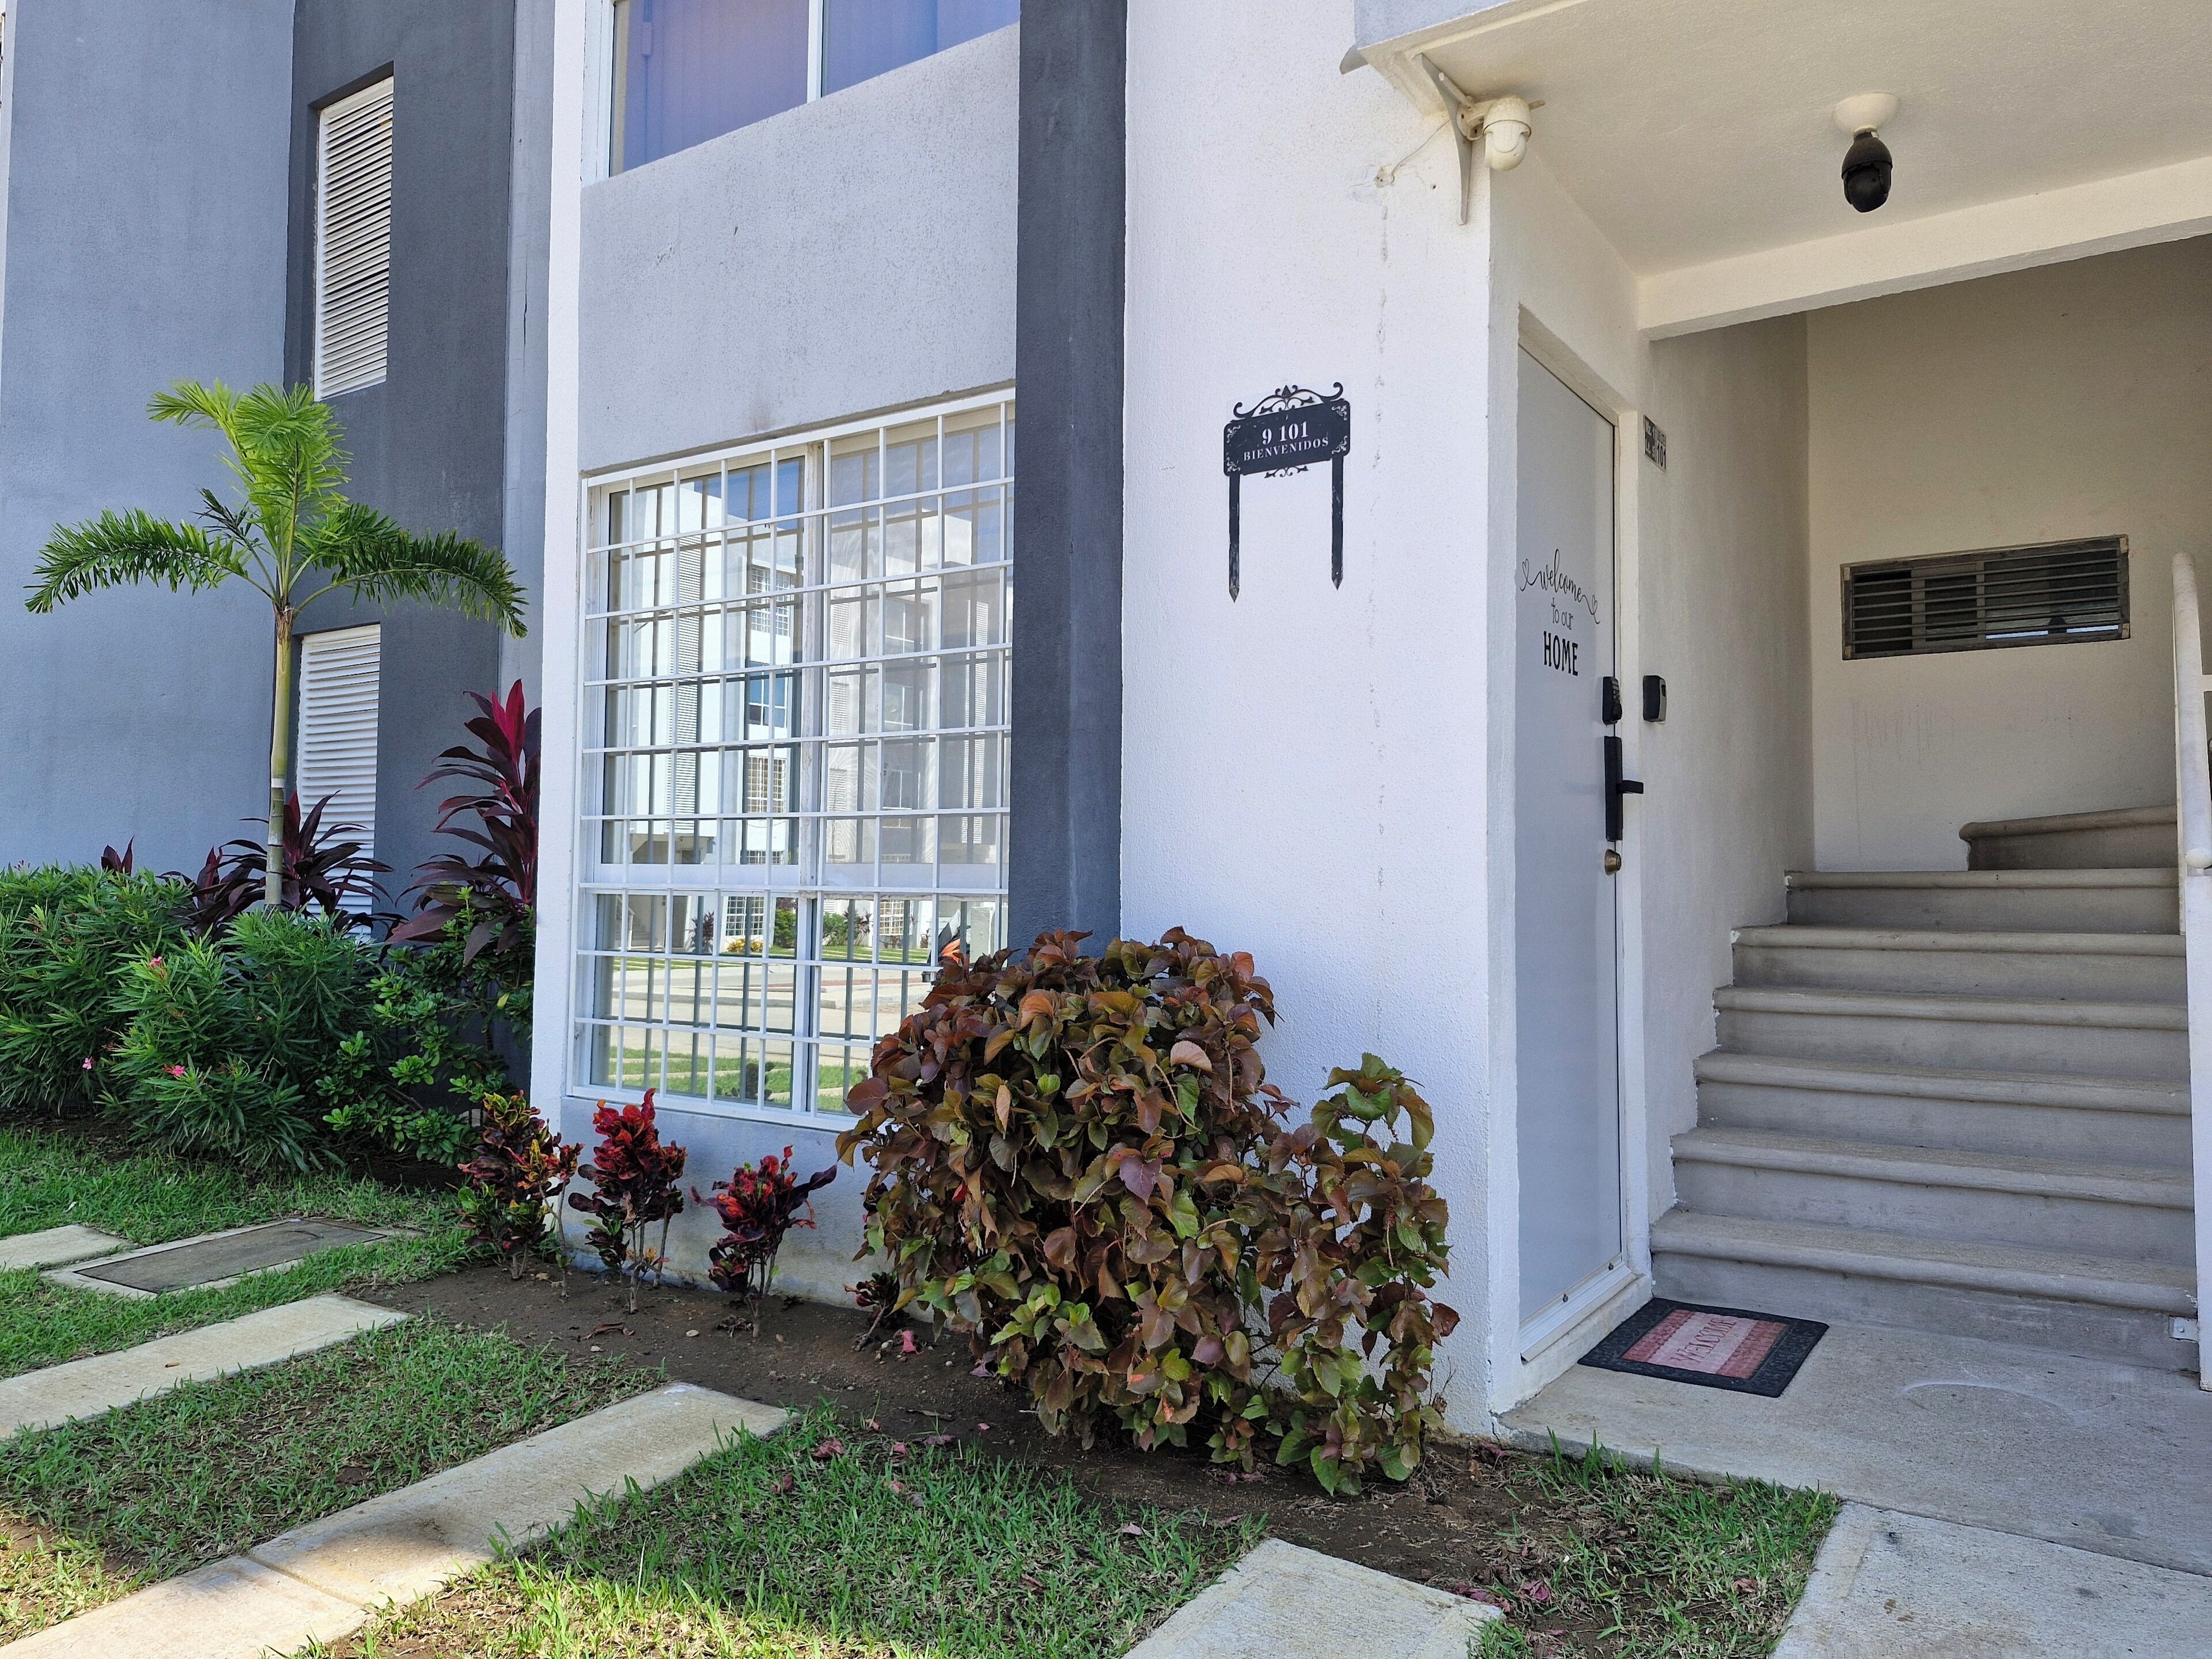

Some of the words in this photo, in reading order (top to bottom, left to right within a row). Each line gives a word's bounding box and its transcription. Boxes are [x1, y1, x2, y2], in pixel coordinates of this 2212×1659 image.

[1244, 437, 1328, 461] BIENVENIDOS
[1262, 428, 1272, 445] 9
[1279, 421, 1308, 442] 101
[1657, 442, 1666, 469] 101
[1538, 548, 1584, 603] welcome
[1551, 597, 1559, 623] to
[1561, 611, 1574, 630] our
[1543, 630, 1578, 676] HOME
[1670, 1317, 1737, 1363] WELCOME
